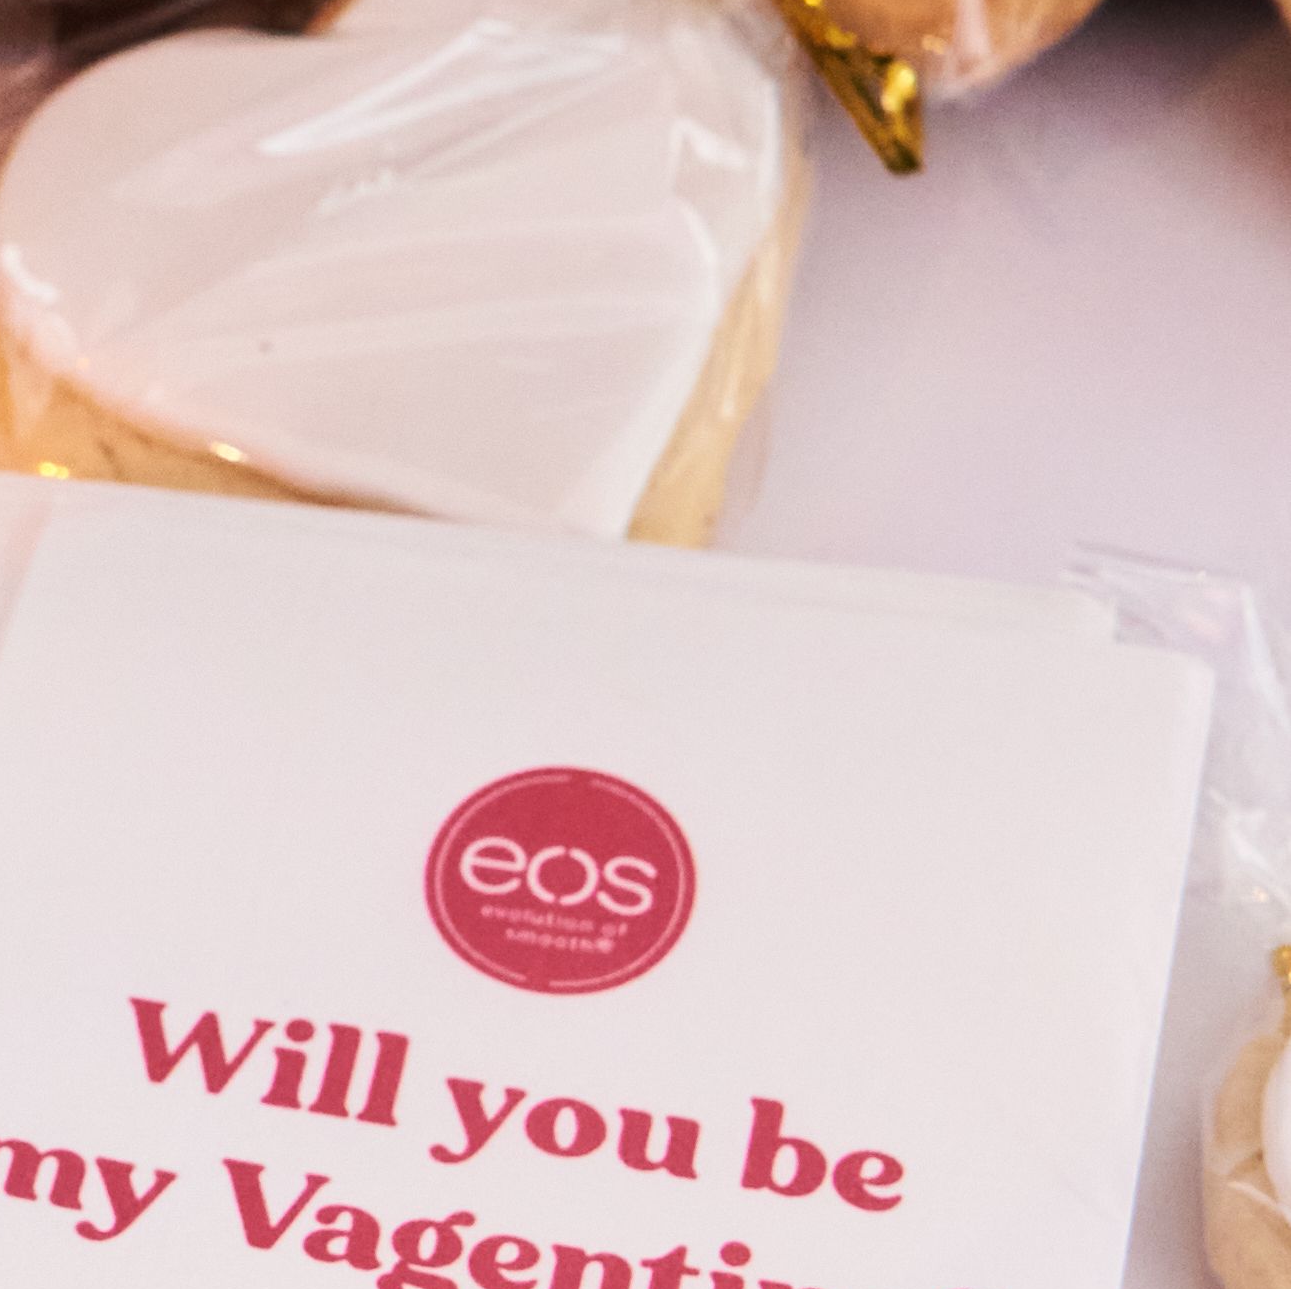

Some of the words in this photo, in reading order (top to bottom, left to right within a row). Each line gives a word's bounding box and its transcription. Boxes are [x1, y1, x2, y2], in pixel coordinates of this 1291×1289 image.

[459, 835, 657, 917] eos
[128, 996, 411, 1128] Will
[427, 1076, 702, 1179] you
[739, 1095, 904, 1214] be
